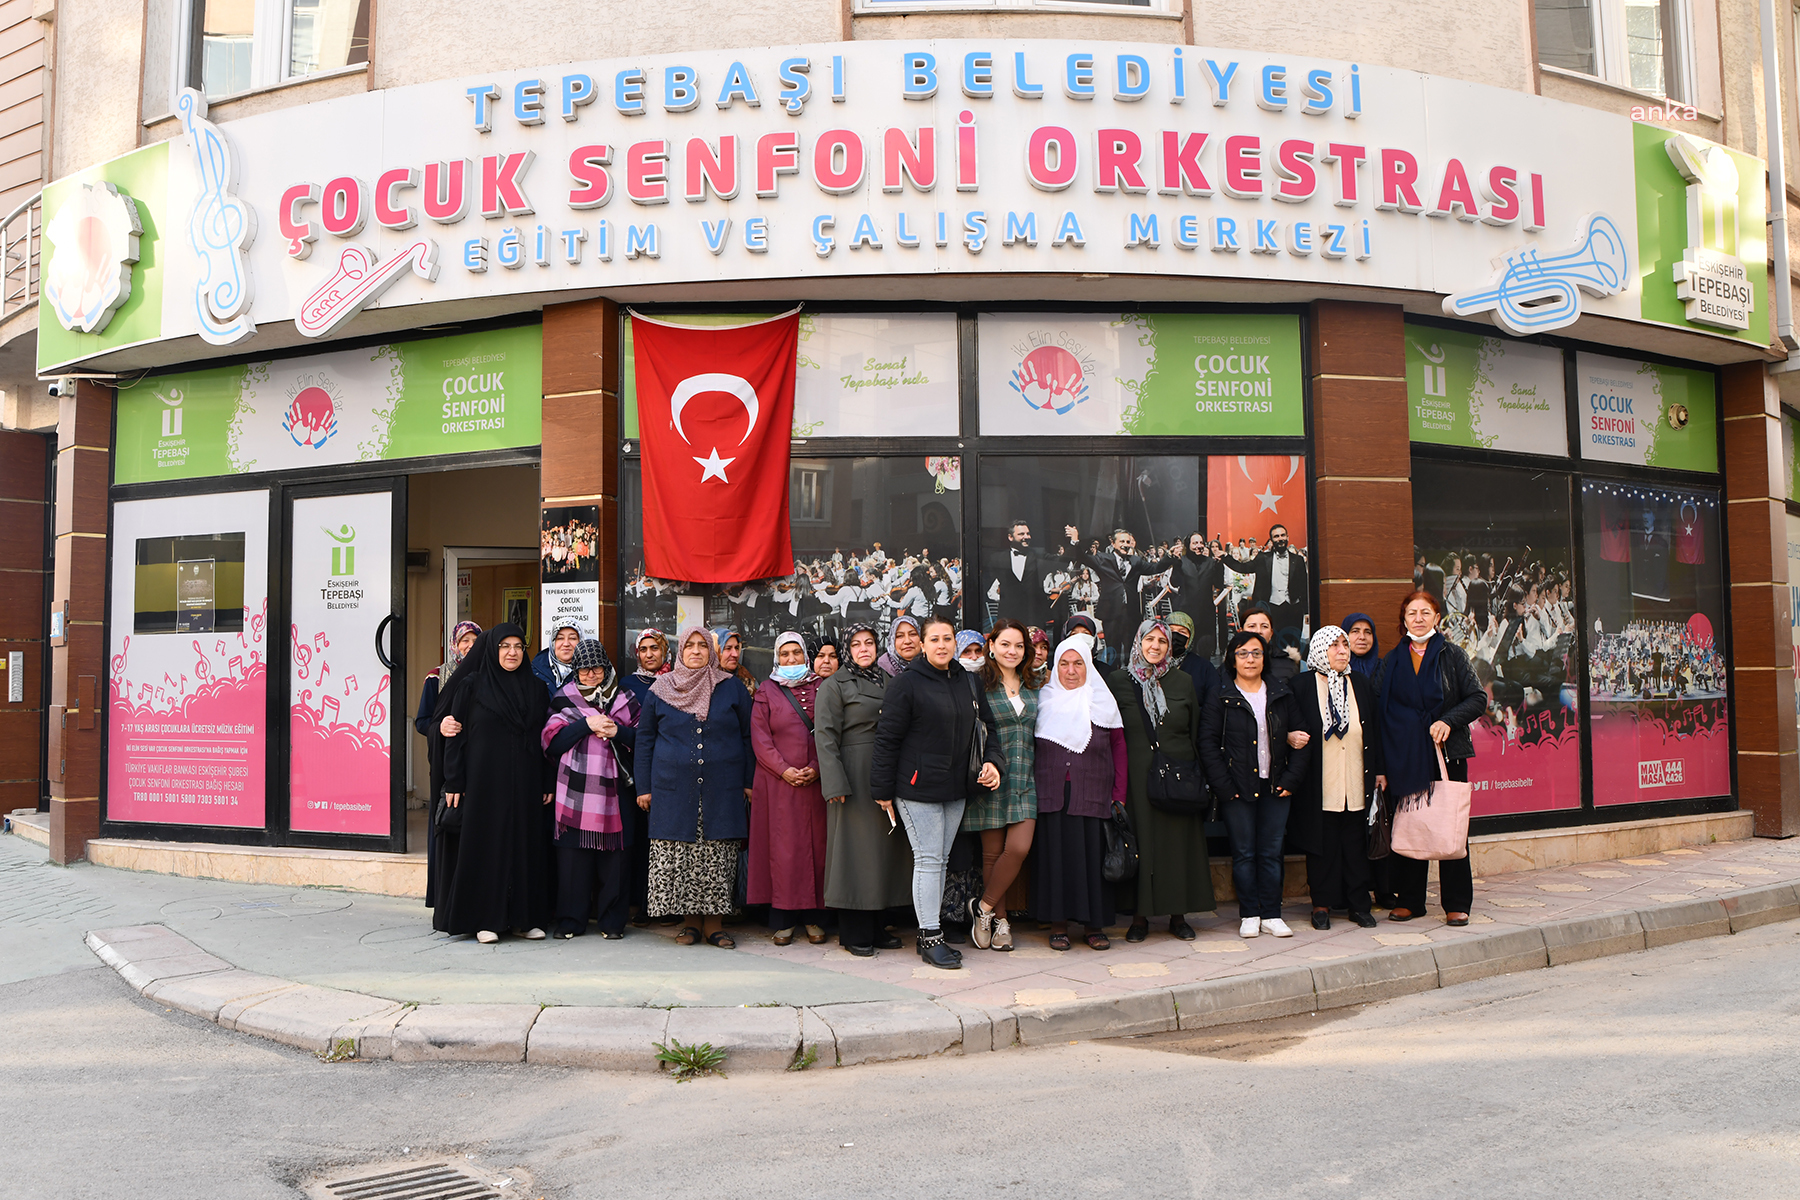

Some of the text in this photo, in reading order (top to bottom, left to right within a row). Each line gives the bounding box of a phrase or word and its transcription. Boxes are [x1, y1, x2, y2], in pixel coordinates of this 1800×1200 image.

[466, 47, 1362, 133] TEPEBAŞI BELEDİYESİ
[279, 108, 1546, 260] ÇOCUK SENFONİ ORKESTRASI
[463, 210, 1372, 273] EĞİTİM VE ÇALIŞMA MERKEZİ
[1698, 255, 1744, 281] ESKİŞEHİR
[1688, 269, 1751, 308] TEPEBAŞI
[1700, 299, 1746, 322] BELEDİYESİ
[1193, 335, 1271, 346] TEPEBAŞI BELEDİYESİ
[863, 356, 907, 372] Sanat
[1194, 354, 1271, 379] ÇOCUK
[442, 371, 505, 401] ÇOCUK
[840, 371, 930, 392] Tepebaşı'nda
[1195, 377, 1272, 397] SENFONİ
[1510, 383, 1537, 396] Sanat
[442, 393, 505, 419] SENFONİ
[1195, 401, 1273, 413] ORKESTRASI
[1497, 397, 1550, 413] Tepebaşı'nda
[1590, 393, 1634, 414] ÇOCUK
[1415, 405, 1456, 423] TEPEBAŞI
[441, 417, 505, 434] ORKESTRASI
[1591, 415, 1635, 435] SENFONİ
[1591, 433, 1636, 448] ORKESTRASI
[152, 447, 190, 459] TEPEBAŞI
[327, 579, 360, 589] ESKİŞEHİR
[320, 588, 364, 601] TEPEBAŞI
[560, 597, 581, 605] ÇOCUK
[557, 605, 584, 613] SENFONİ
[145, 723, 160, 733] ARASI
[1665, 761, 1683, 774] 444
[1641, 773, 1664, 786] MASA
